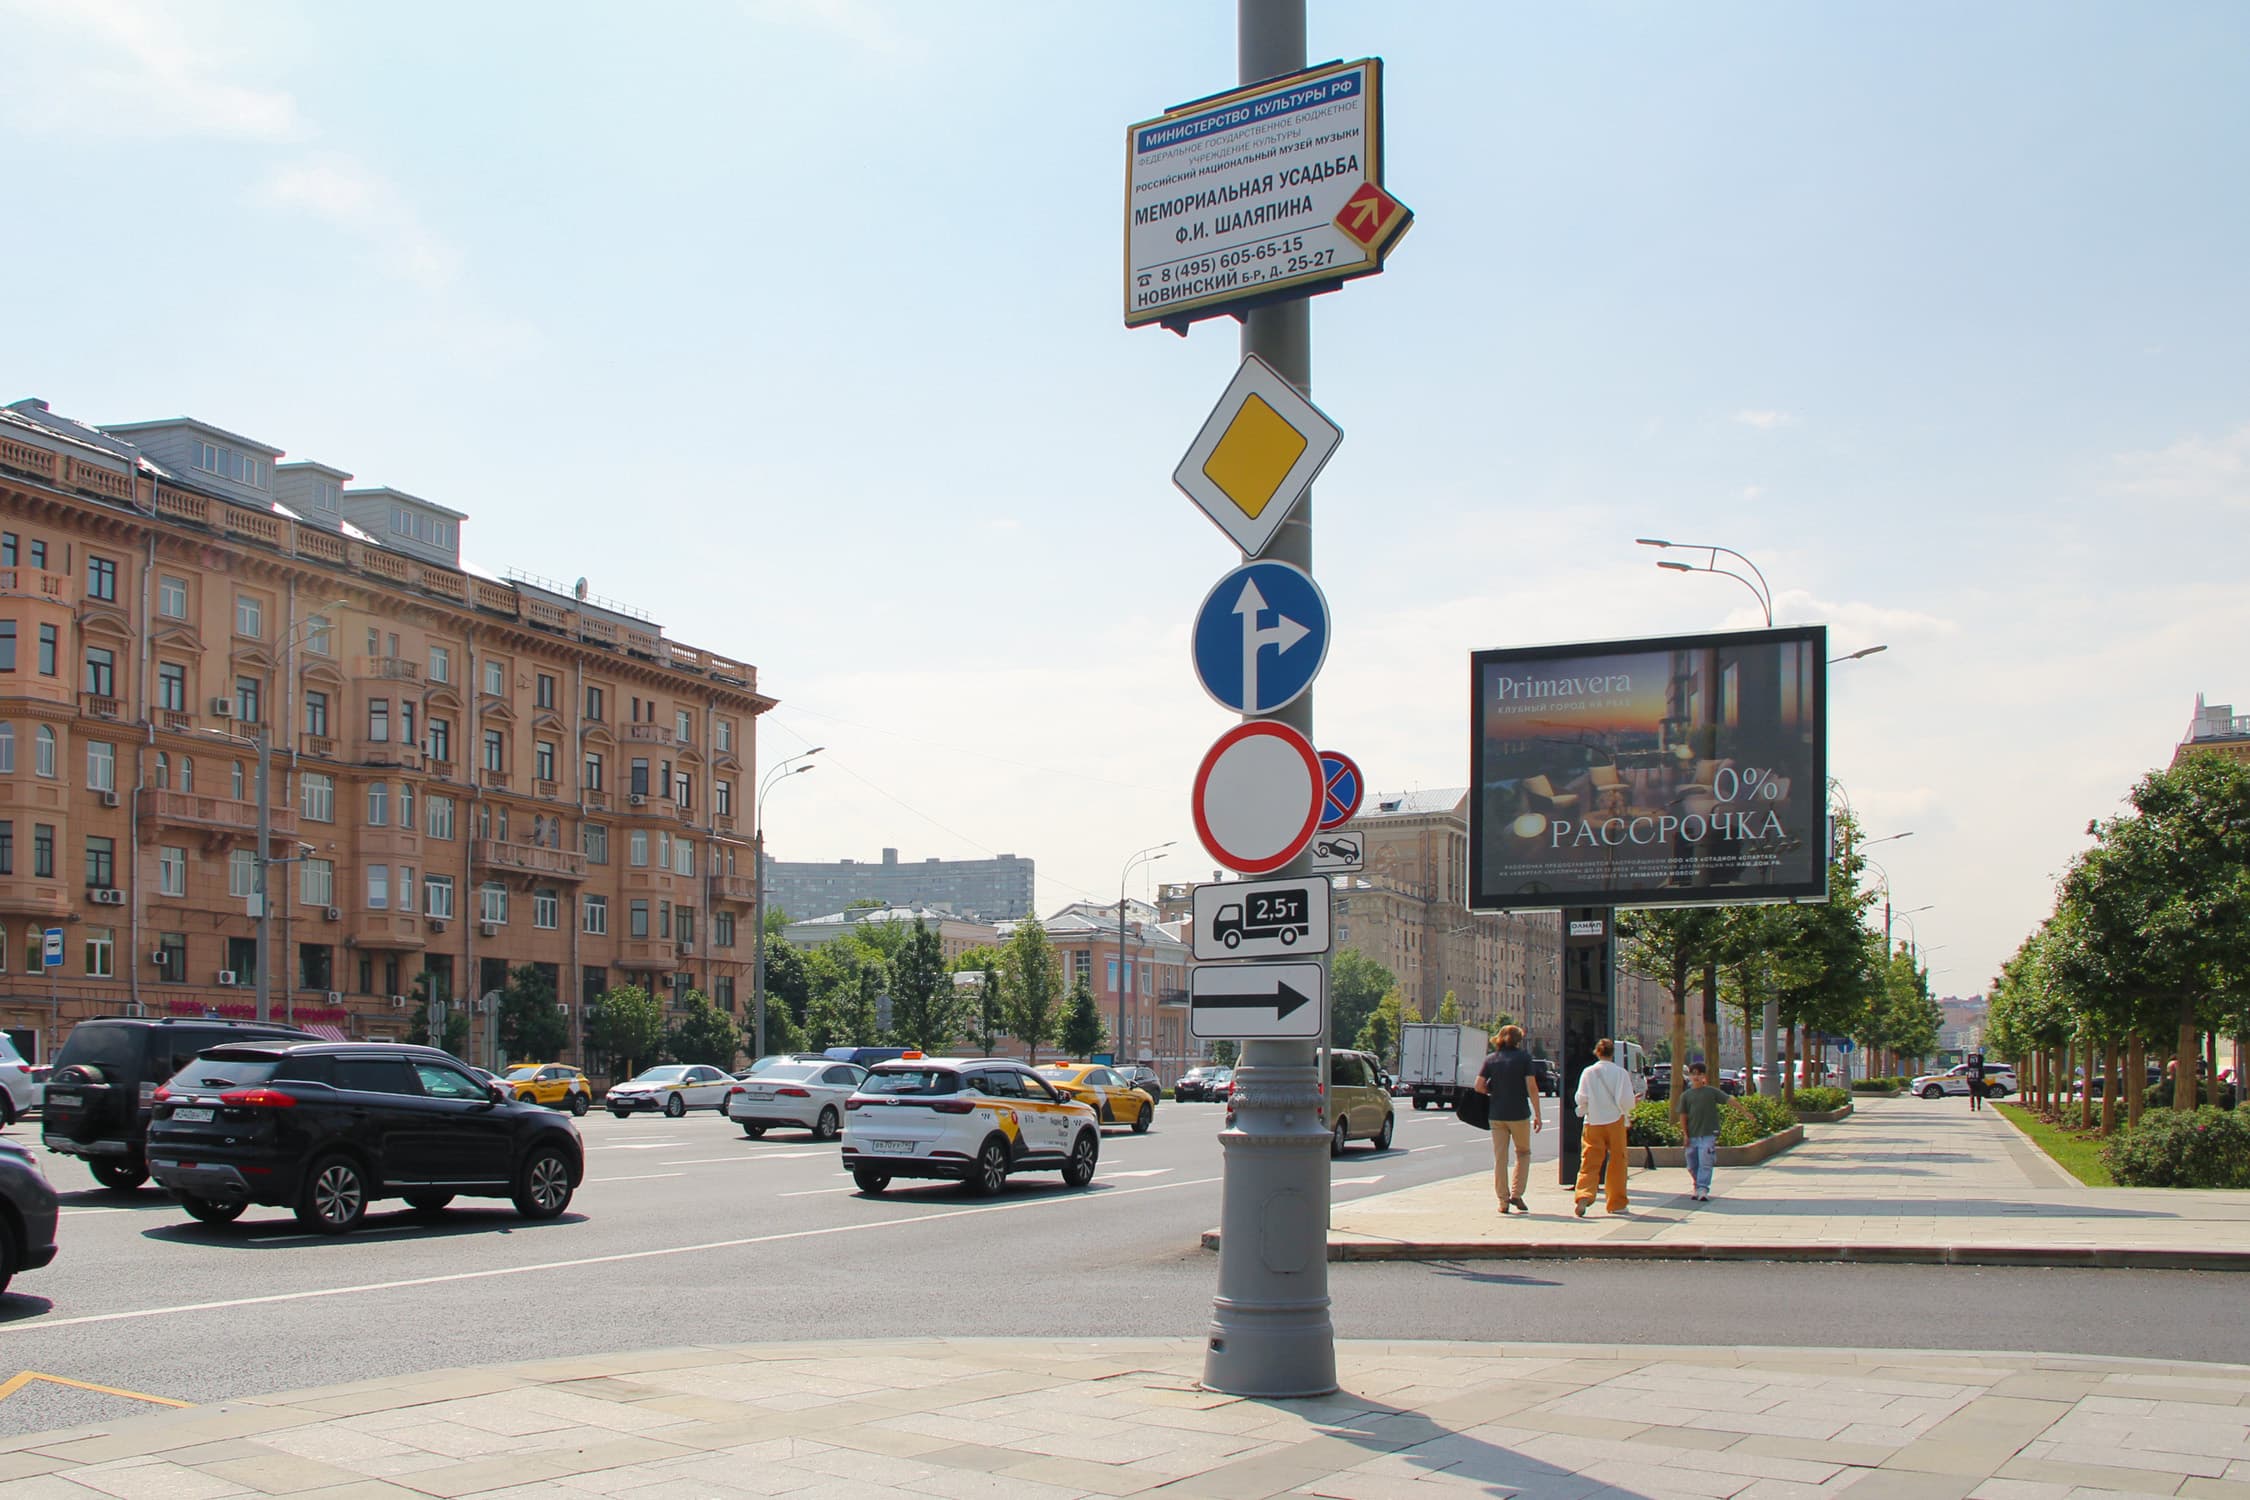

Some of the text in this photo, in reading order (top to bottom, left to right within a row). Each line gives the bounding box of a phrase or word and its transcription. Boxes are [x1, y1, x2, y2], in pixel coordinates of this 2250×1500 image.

[1138, 100, 1358, 167] ФЕДЕРАЛЬНОЕ ГОСУДАРСТВЕННОЕ БЮДЖЕТНОЕ
[1145, 80, 1353, 147] МИНИСТЕРСТВО КУЛЬТУРЫ РФ
[1135, 127, 1359, 193] РОССИЙСКИЙ НАЦИОНАЛЬНЫЙ МУЗЕЙ МУЗЫКИ
[1189, 128, 1301, 165] УЧРЕЖДЕНИЕ КУЛЬТУРЫ
[1135, 154, 1359, 226] МЕМОРИАЛЬНАЯ УСАДЬБА
[1175, 195, 1313, 244] Ф.И. ШАЛЯПИНА
[1137, 268, 1238, 307] НОВИНСКИЙ
[1288, 249, 1335, 273] 25-27
[1161, 236, 1303, 282] 8 (495) 605-65-15
[1497, 674, 1632, 700] Primavera
[1713, 767, 1779, 803] 0%
[1551, 809, 1787, 848] РАССРОЧКА
